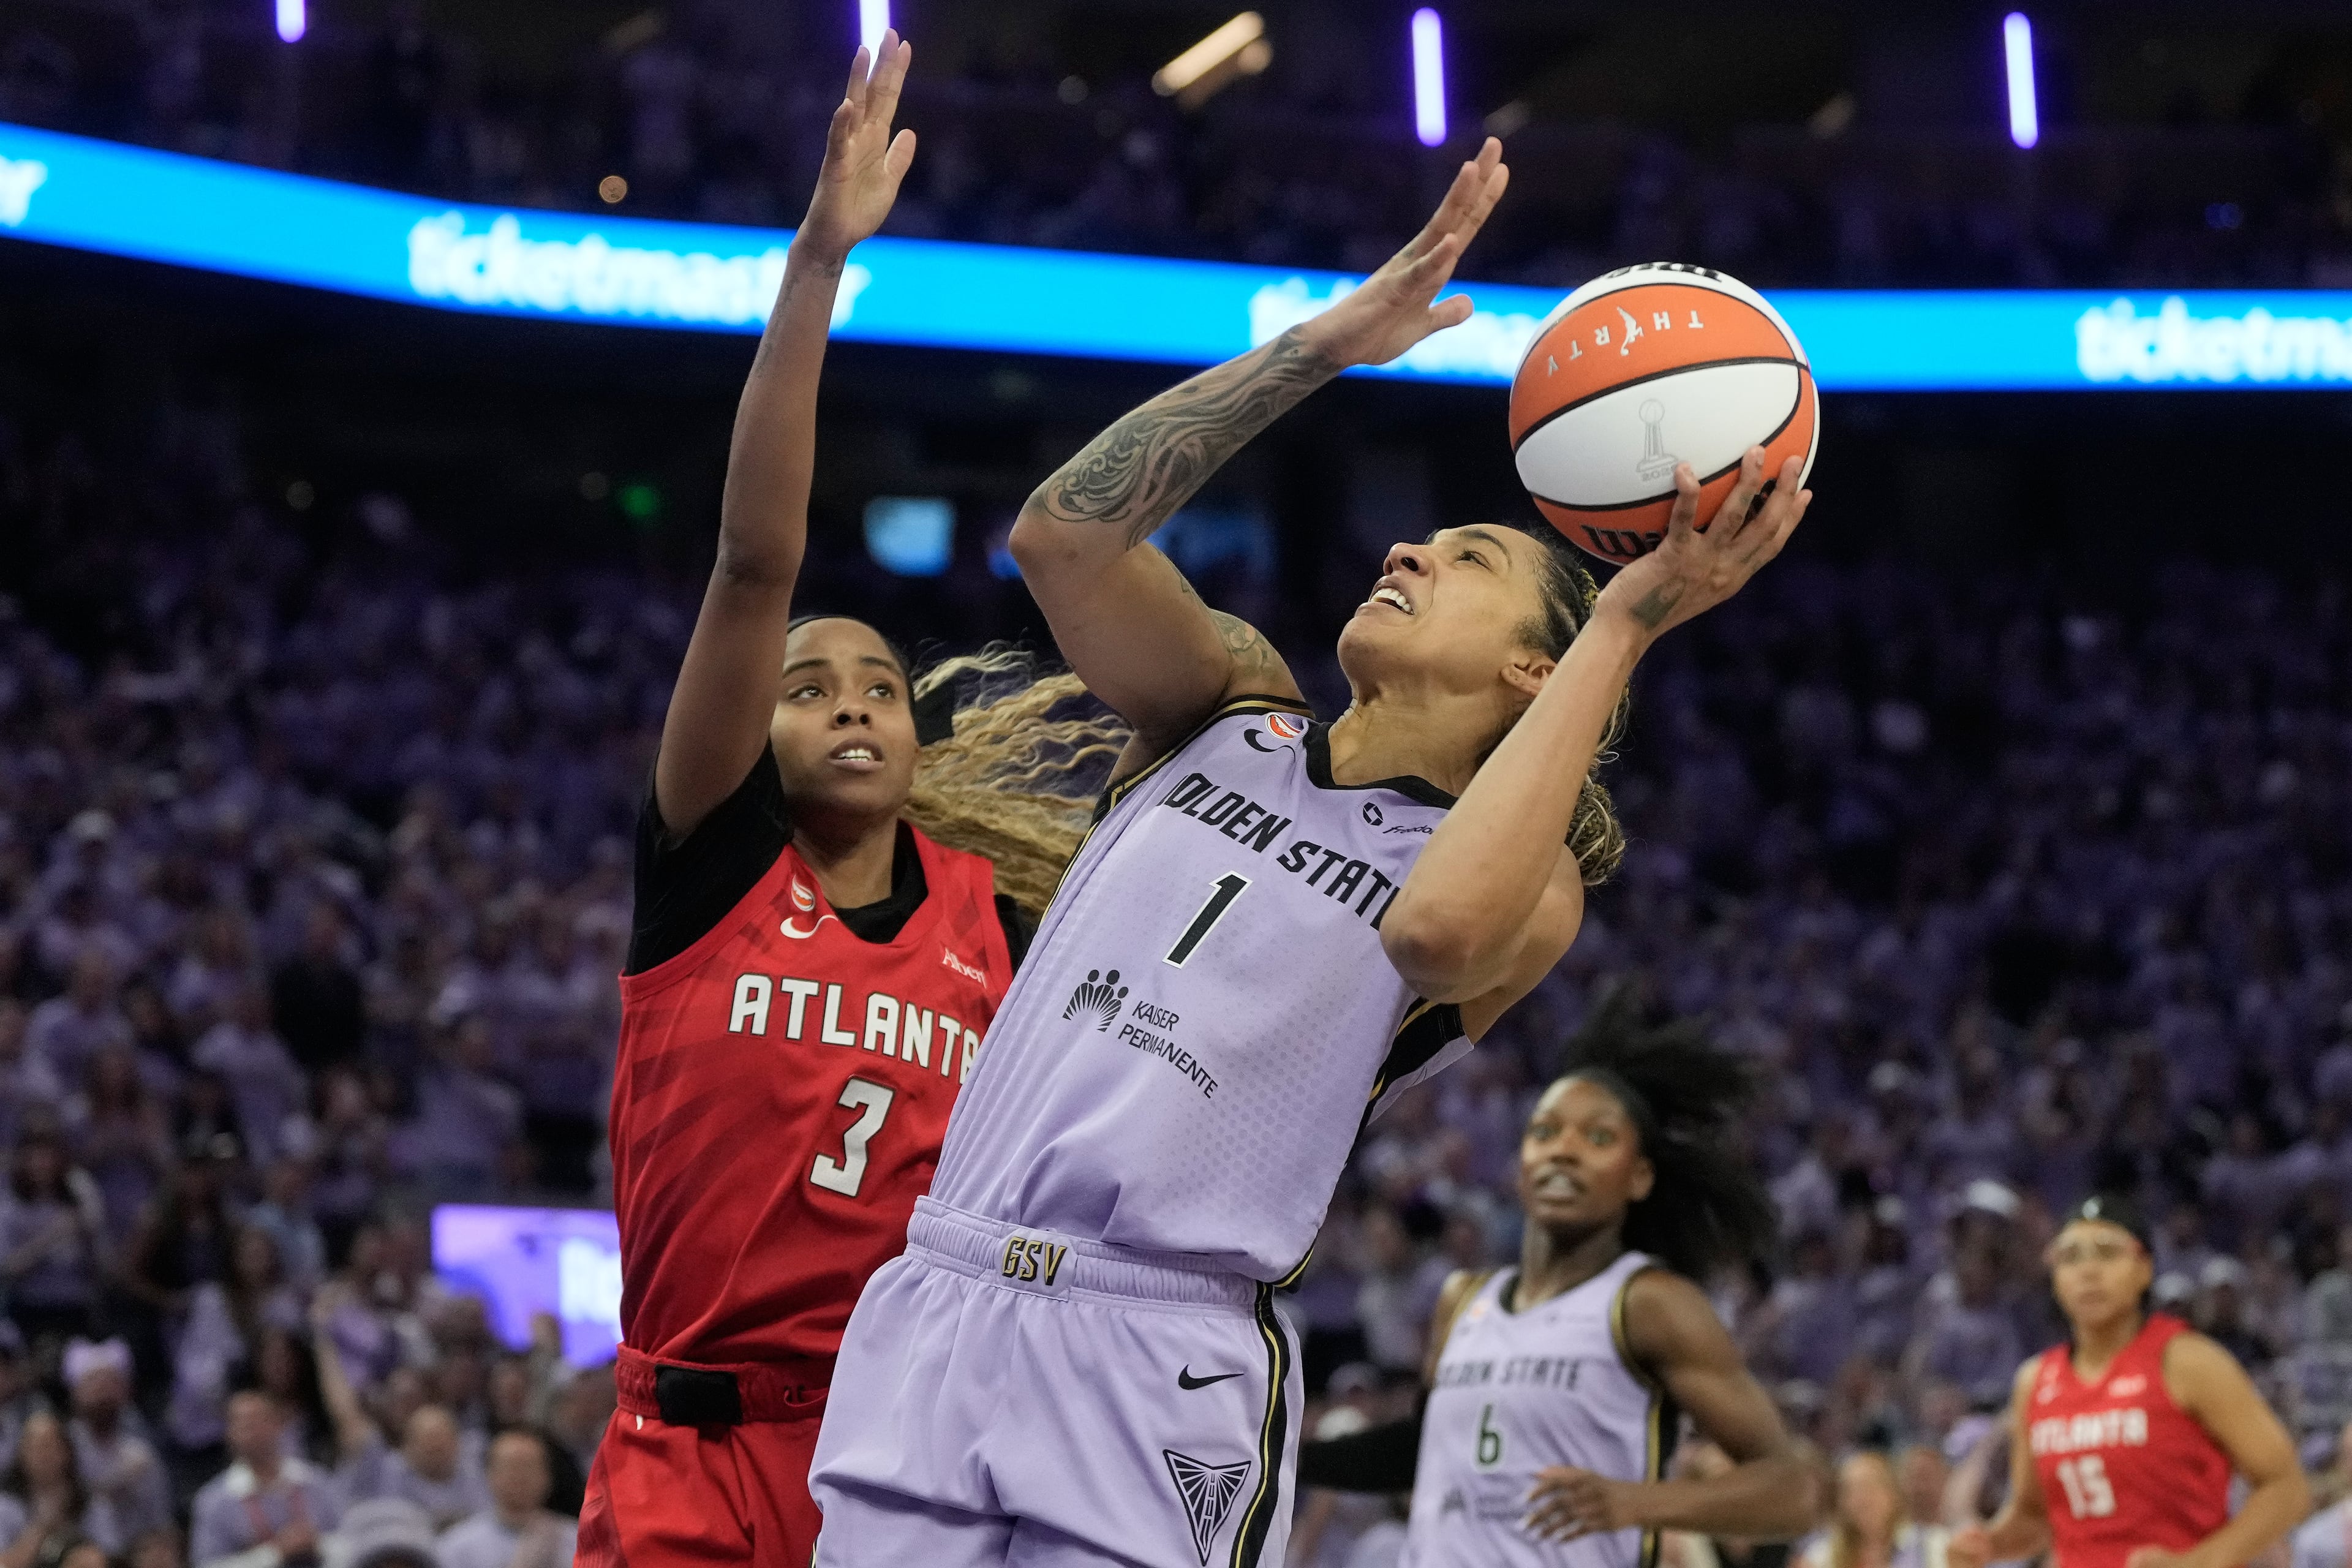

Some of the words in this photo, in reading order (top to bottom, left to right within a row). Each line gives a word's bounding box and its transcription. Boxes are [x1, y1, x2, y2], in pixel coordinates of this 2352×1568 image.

[409, 211, 872, 330] ticketmastr
[1156, 772, 1292, 854] OLDEN
[1162, 870, 1253, 970] 1
[1132, 1000, 1180, 1031] KAISER
[1118, 1023, 1218, 1099] PERMANENTE
[809, 1076, 895, 1197] 3
[1001, 1236, 1067, 1286] GSV
[1477, 1403, 1501, 1466] 6
[2057, 1454, 2117, 1520] 15
